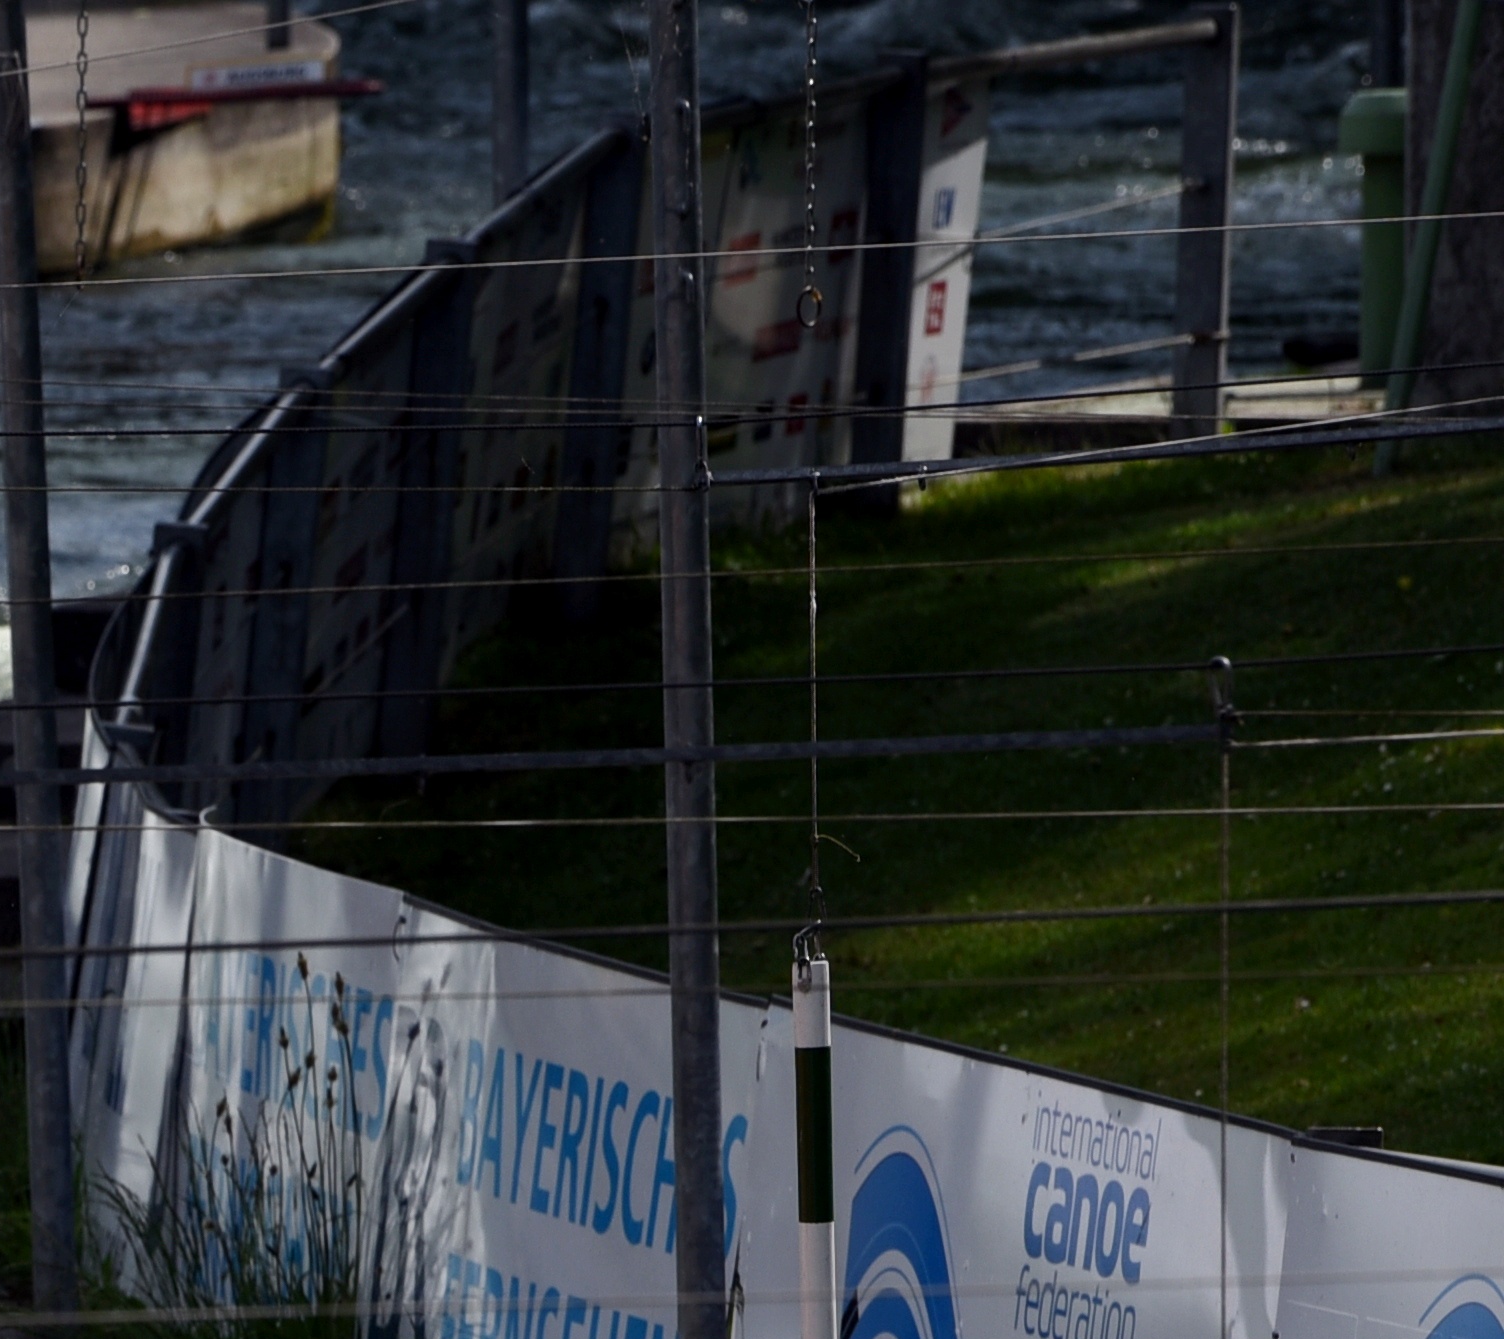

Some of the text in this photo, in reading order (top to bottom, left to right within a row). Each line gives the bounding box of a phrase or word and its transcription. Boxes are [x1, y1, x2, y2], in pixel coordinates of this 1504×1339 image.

[455, 1038, 749, 1259] BAYERISCHS
[1031, 1100, 1162, 1182] international
[1023, 1161, 1152, 1285] canoe
